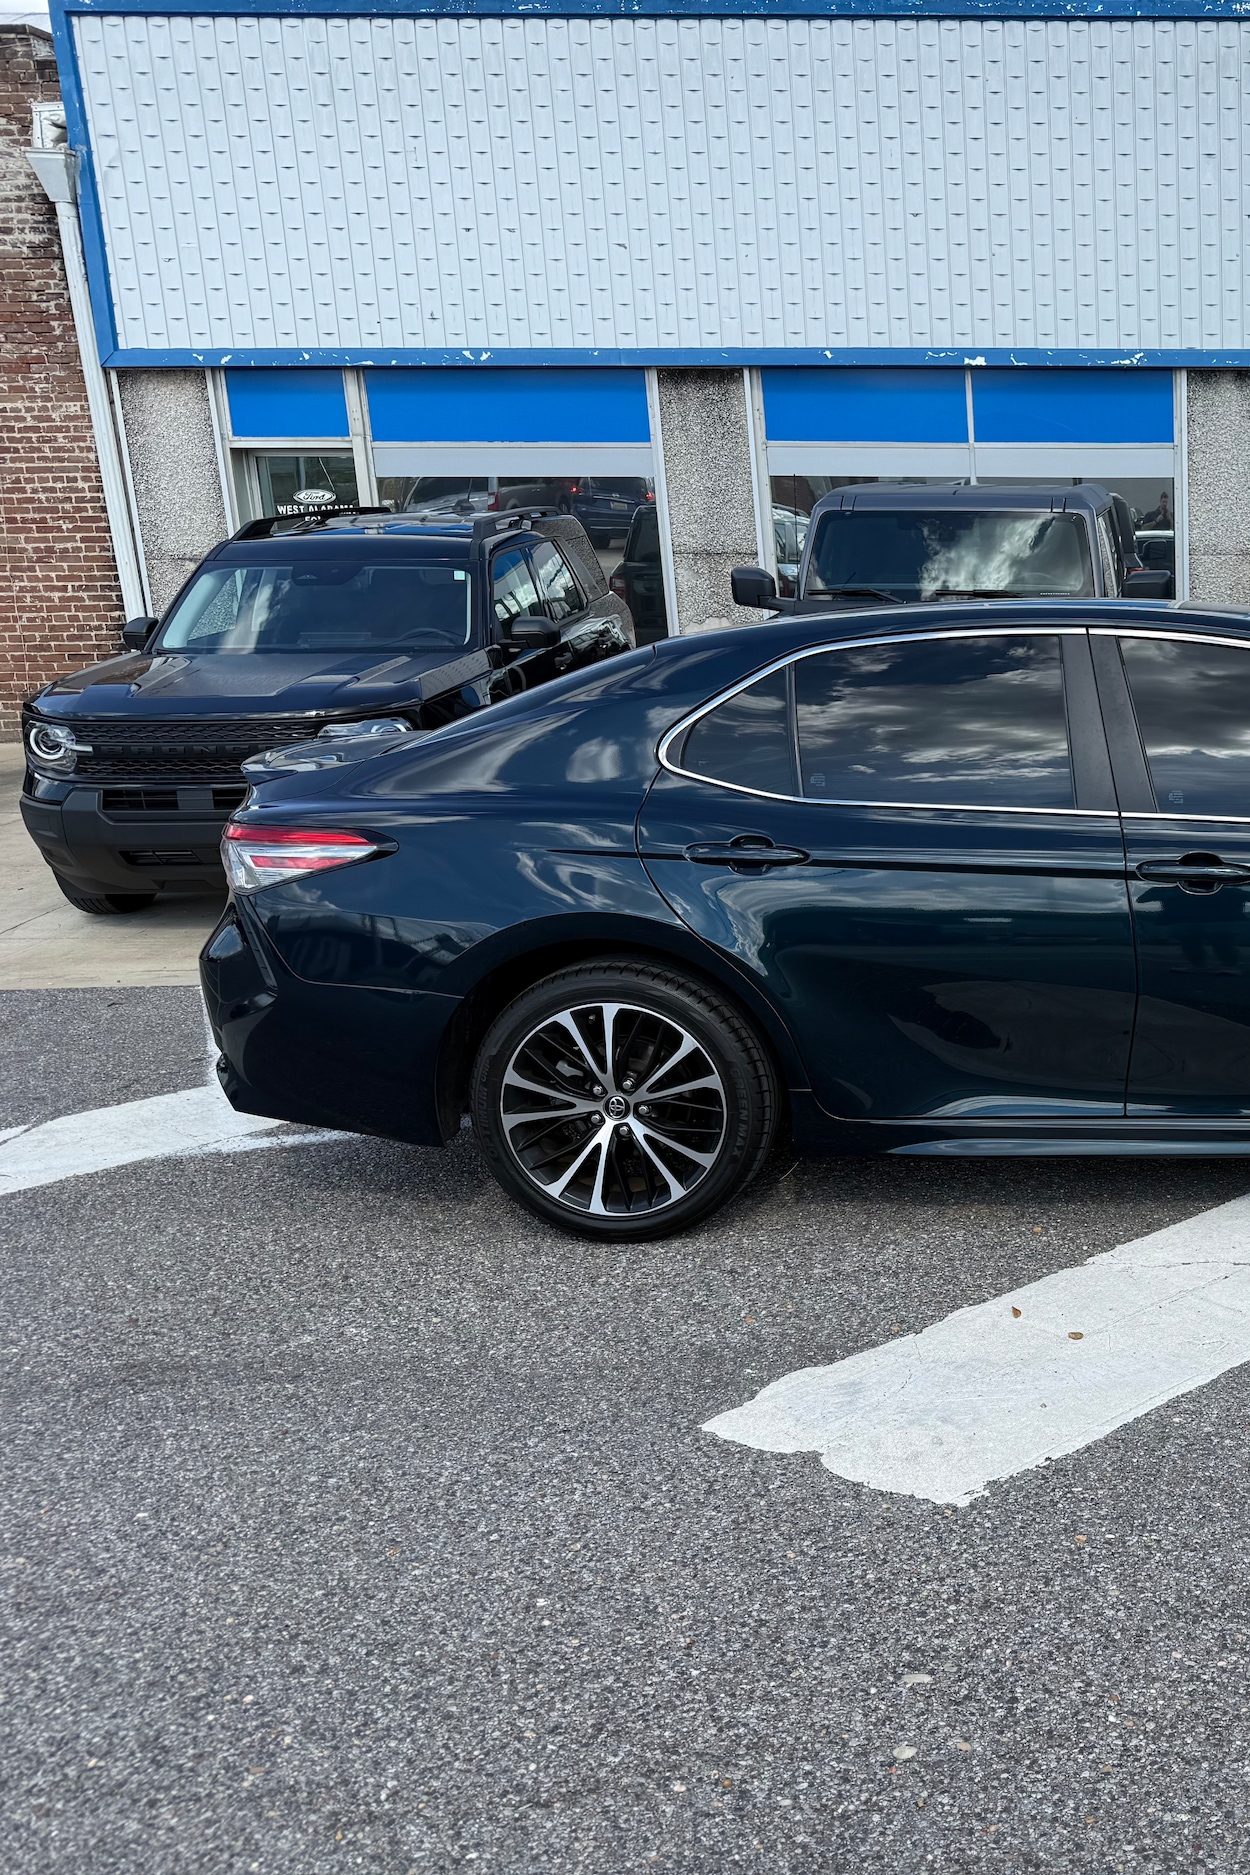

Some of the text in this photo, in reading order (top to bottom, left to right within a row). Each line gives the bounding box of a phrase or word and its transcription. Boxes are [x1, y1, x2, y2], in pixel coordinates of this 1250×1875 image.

[277, 505, 305, 515] WEST
[477, 1084, 497, 1158] OPTIMUM
[729, 1068, 749, 1158] GREEN MAX
